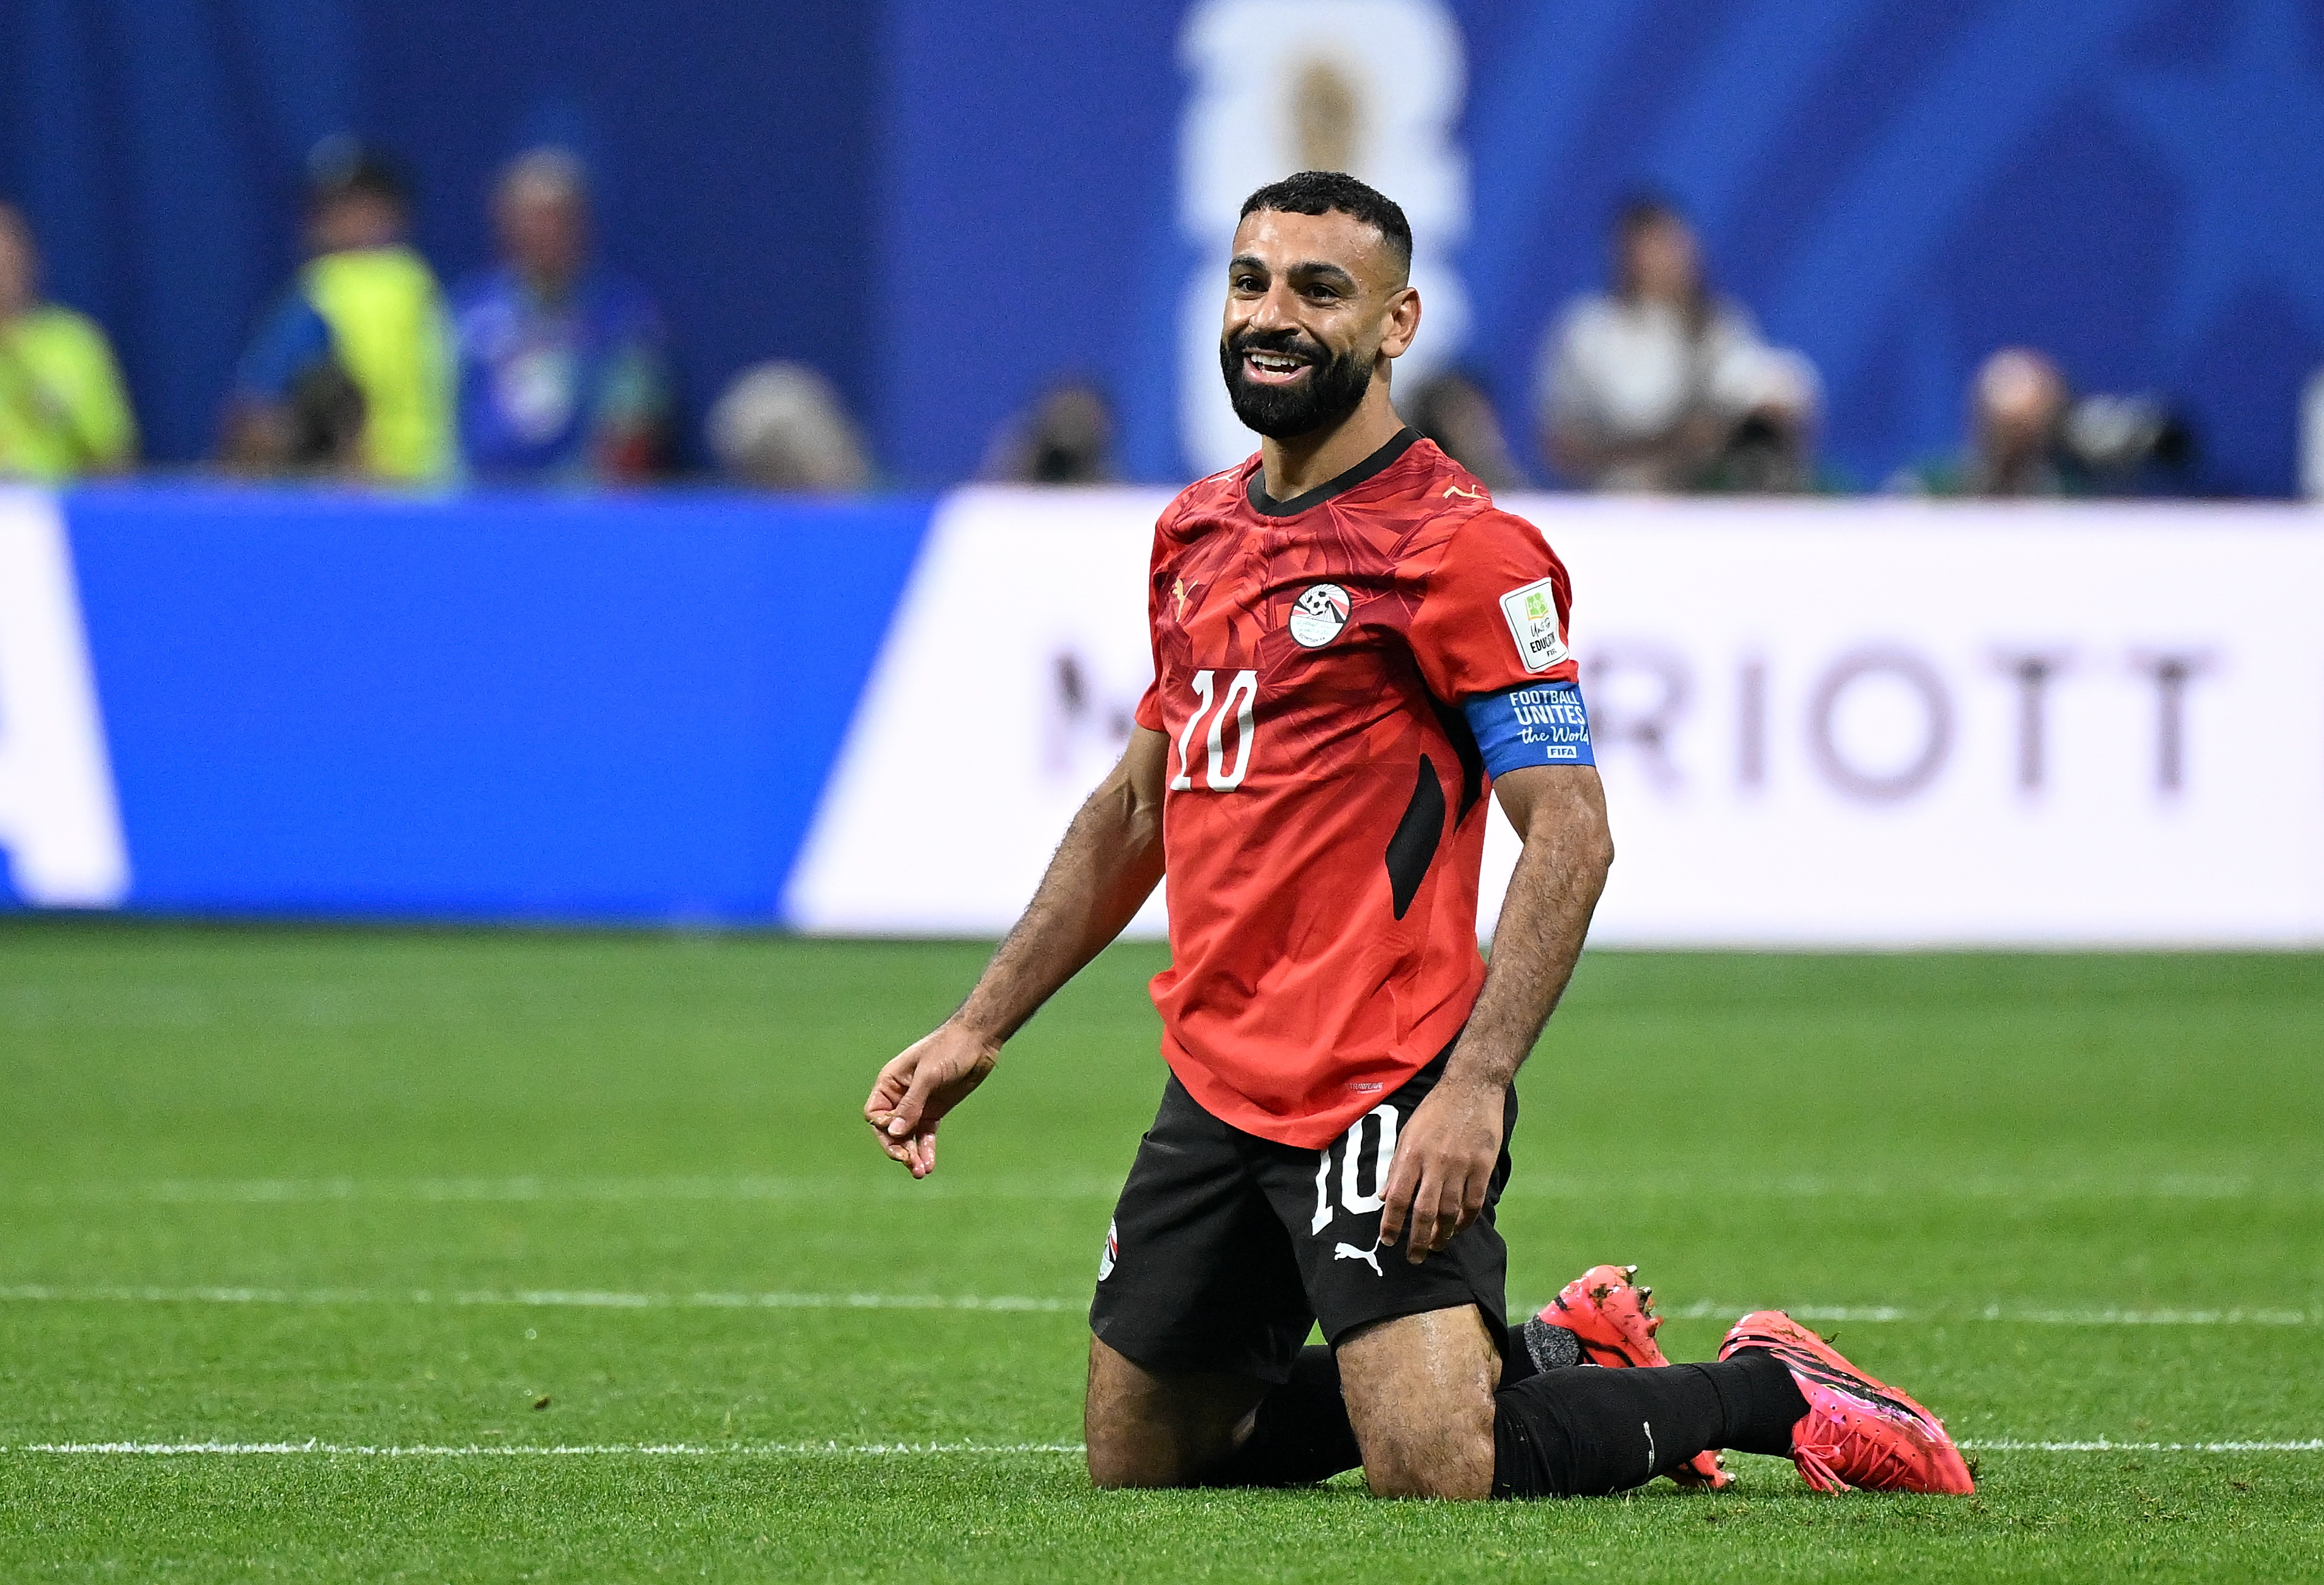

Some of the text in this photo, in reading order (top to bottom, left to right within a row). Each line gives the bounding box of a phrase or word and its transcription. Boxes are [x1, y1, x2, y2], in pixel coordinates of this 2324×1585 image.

[1509, 690, 1580, 706] FOOTBALL
[1043, 648, 2224, 798] MRIOTT
[1514, 704, 1585, 725] UNITES
[1170, 670, 1258, 792] 10
[1517, 725, 1589, 746] the World
[1550, 748, 1575, 756] FIFA
[1311, 1104, 1399, 1236] 10
